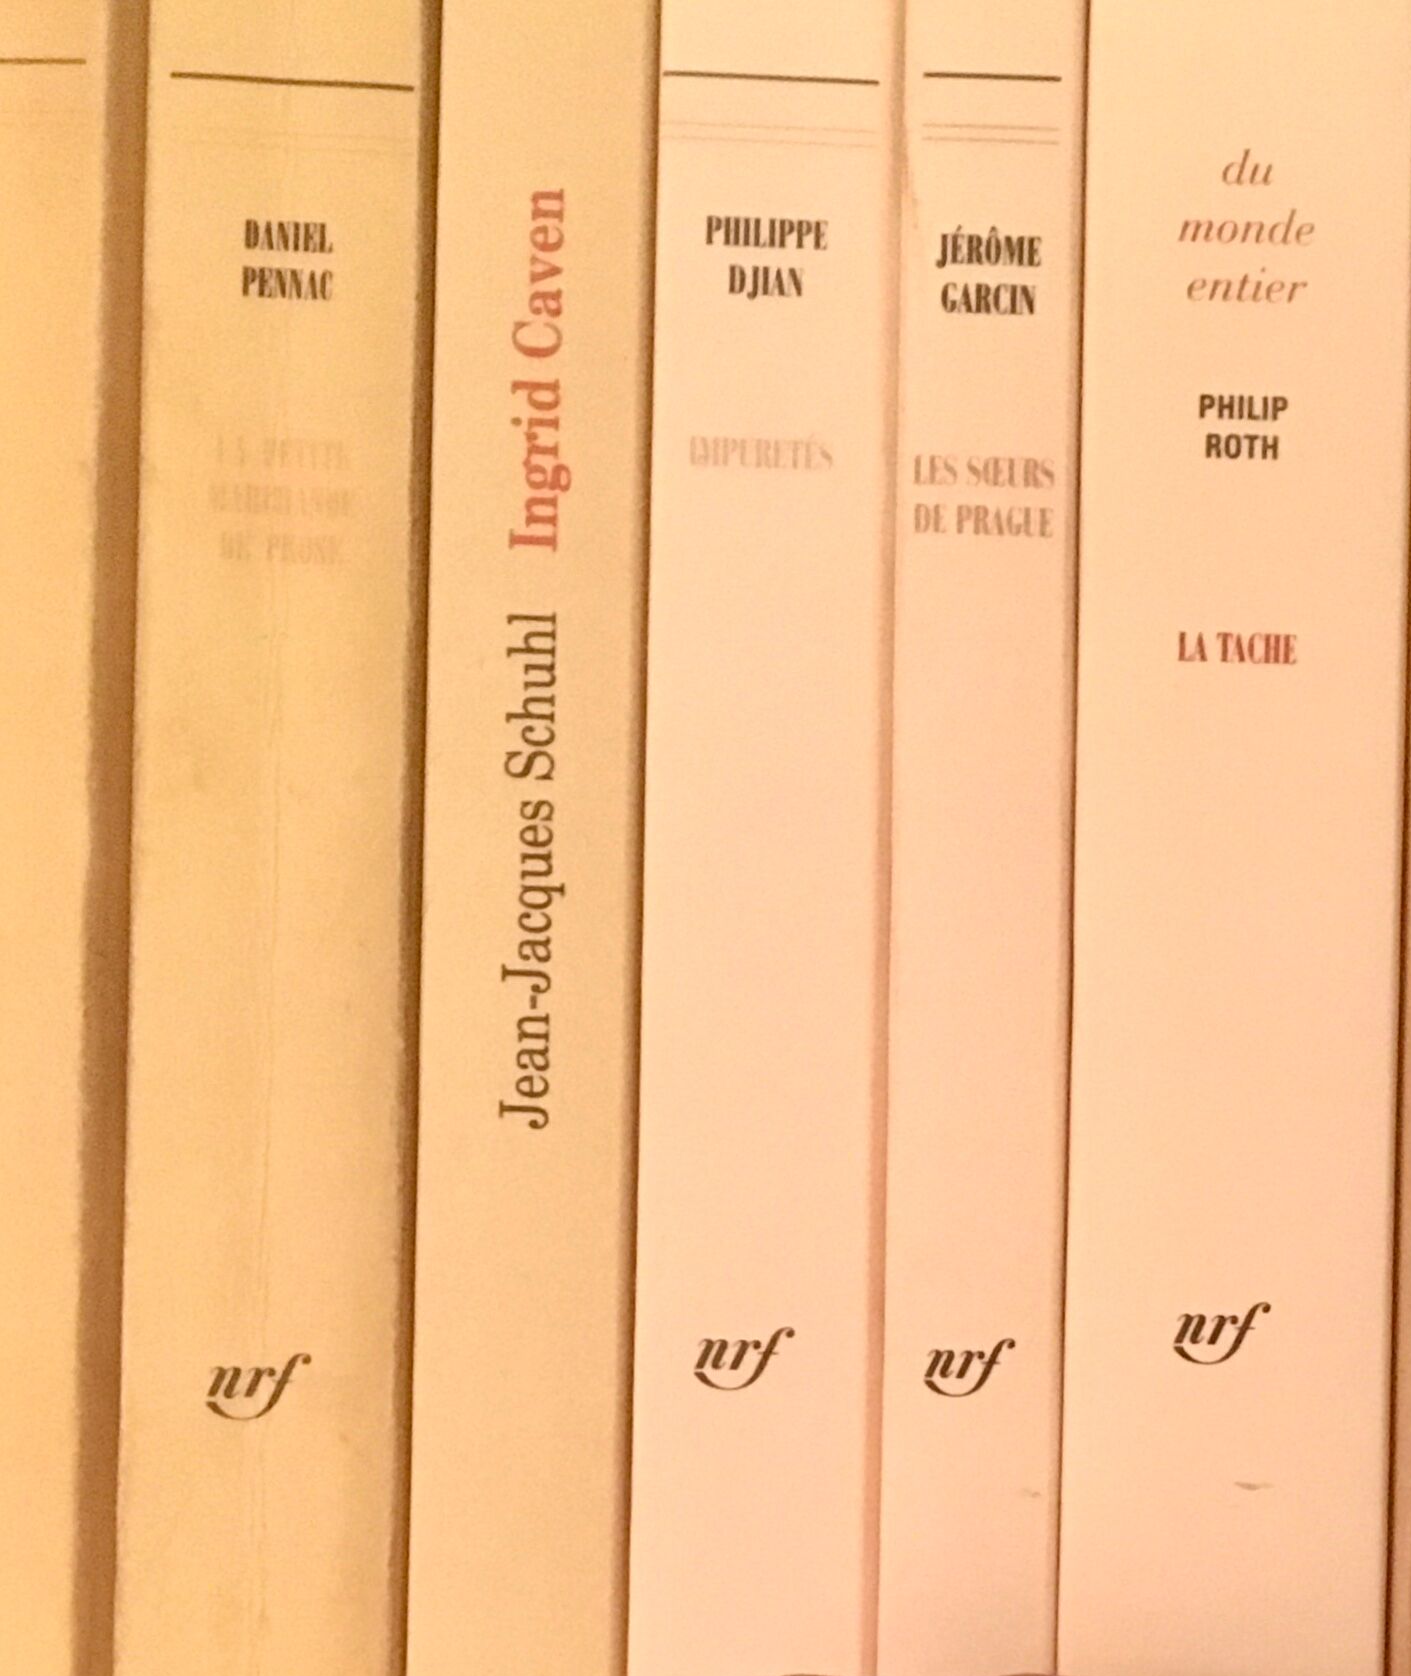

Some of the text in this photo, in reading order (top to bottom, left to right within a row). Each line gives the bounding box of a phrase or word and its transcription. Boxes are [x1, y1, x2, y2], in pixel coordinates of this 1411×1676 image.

[1221, 148, 1274, 186] du
[244, 219, 333, 254] DANIEL
[705, 215, 828, 250] PHILIPPE
[1177, 209, 1315, 246] monde
[936, 225, 1042, 268] JÉRÔME
[242, 266, 333, 301] PENNAC
[728, 264, 803, 300] DJIAN
[941, 282, 1036, 315] GARCIN
[1186, 267, 1308, 303] entier
[510, 188, 570, 553] Ingrid Caven
[1199, 394, 1288, 422] PHILIP
[1204, 433, 1279, 460] ROTH
[913, 454, 957, 486] LES
[914, 504, 1053, 537] DE PRAGUE
[1177, 632, 1297, 664] LA TACHE
[499, 612, 565, 1131] Jean-Jacques Schuhl
[1173, 1301, 1272, 1365] nrf
[694, 1326, 796, 1390] nrf
[924, 1338, 1016, 1397] nrf
[206, 1353, 312, 1420] nrf
